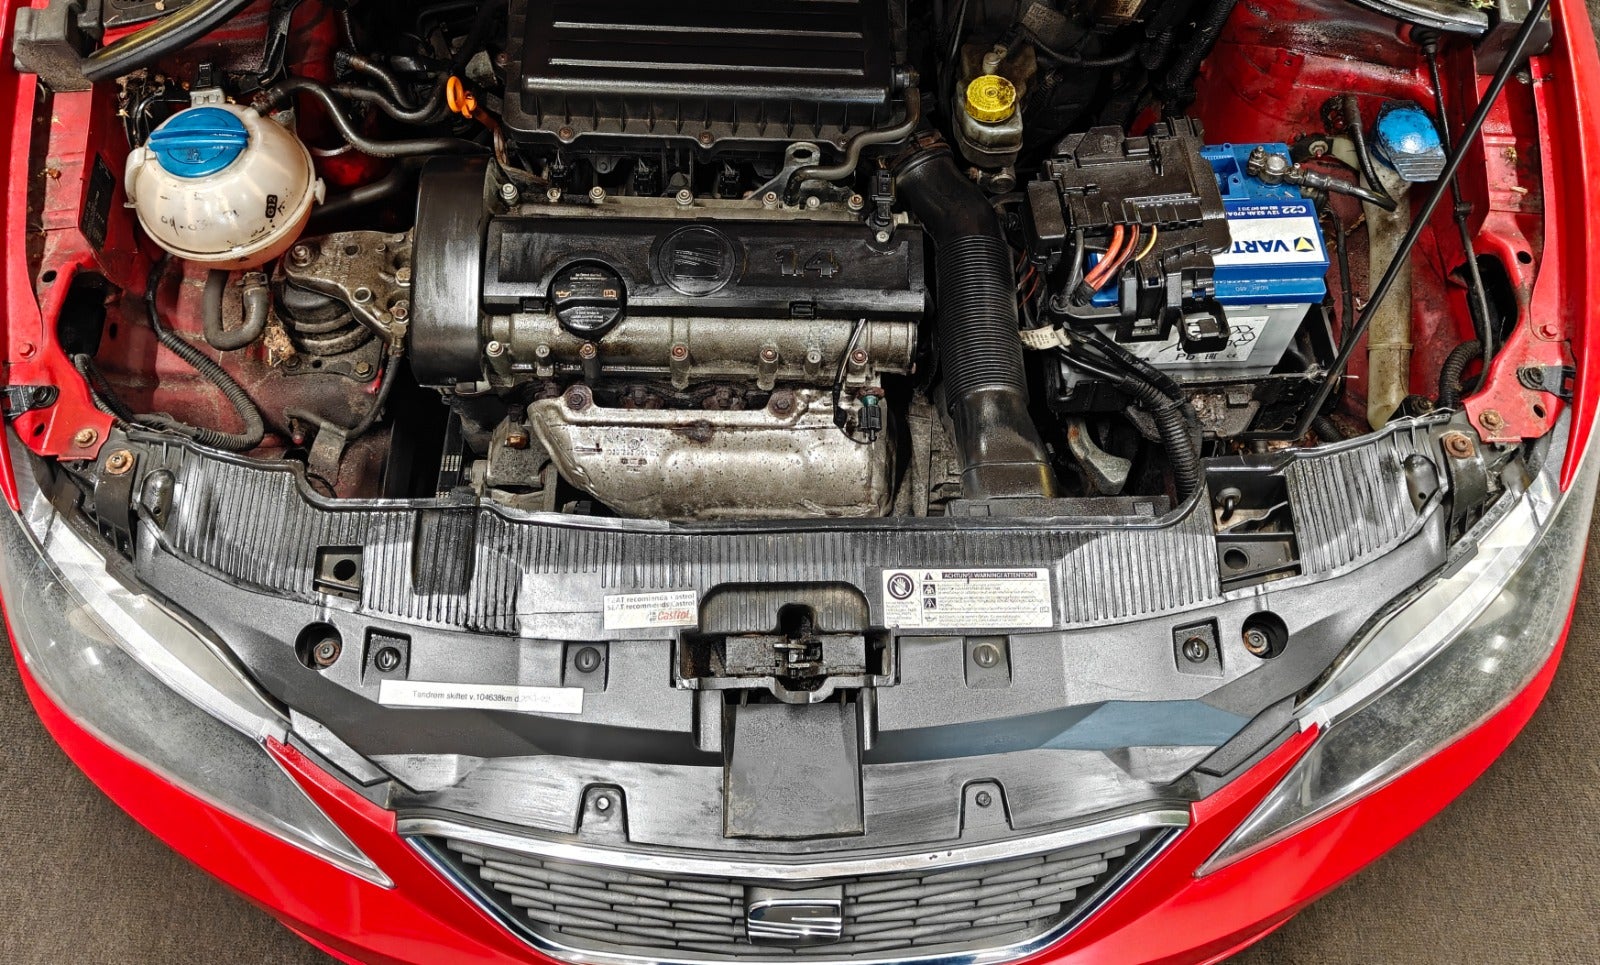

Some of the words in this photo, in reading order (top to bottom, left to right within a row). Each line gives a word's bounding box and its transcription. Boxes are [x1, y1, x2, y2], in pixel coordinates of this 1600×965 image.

[1281, 205, 1307, 214] C22
[1225, 239, 1290, 254] VART
[657, 609, 690, 621] Castrol
